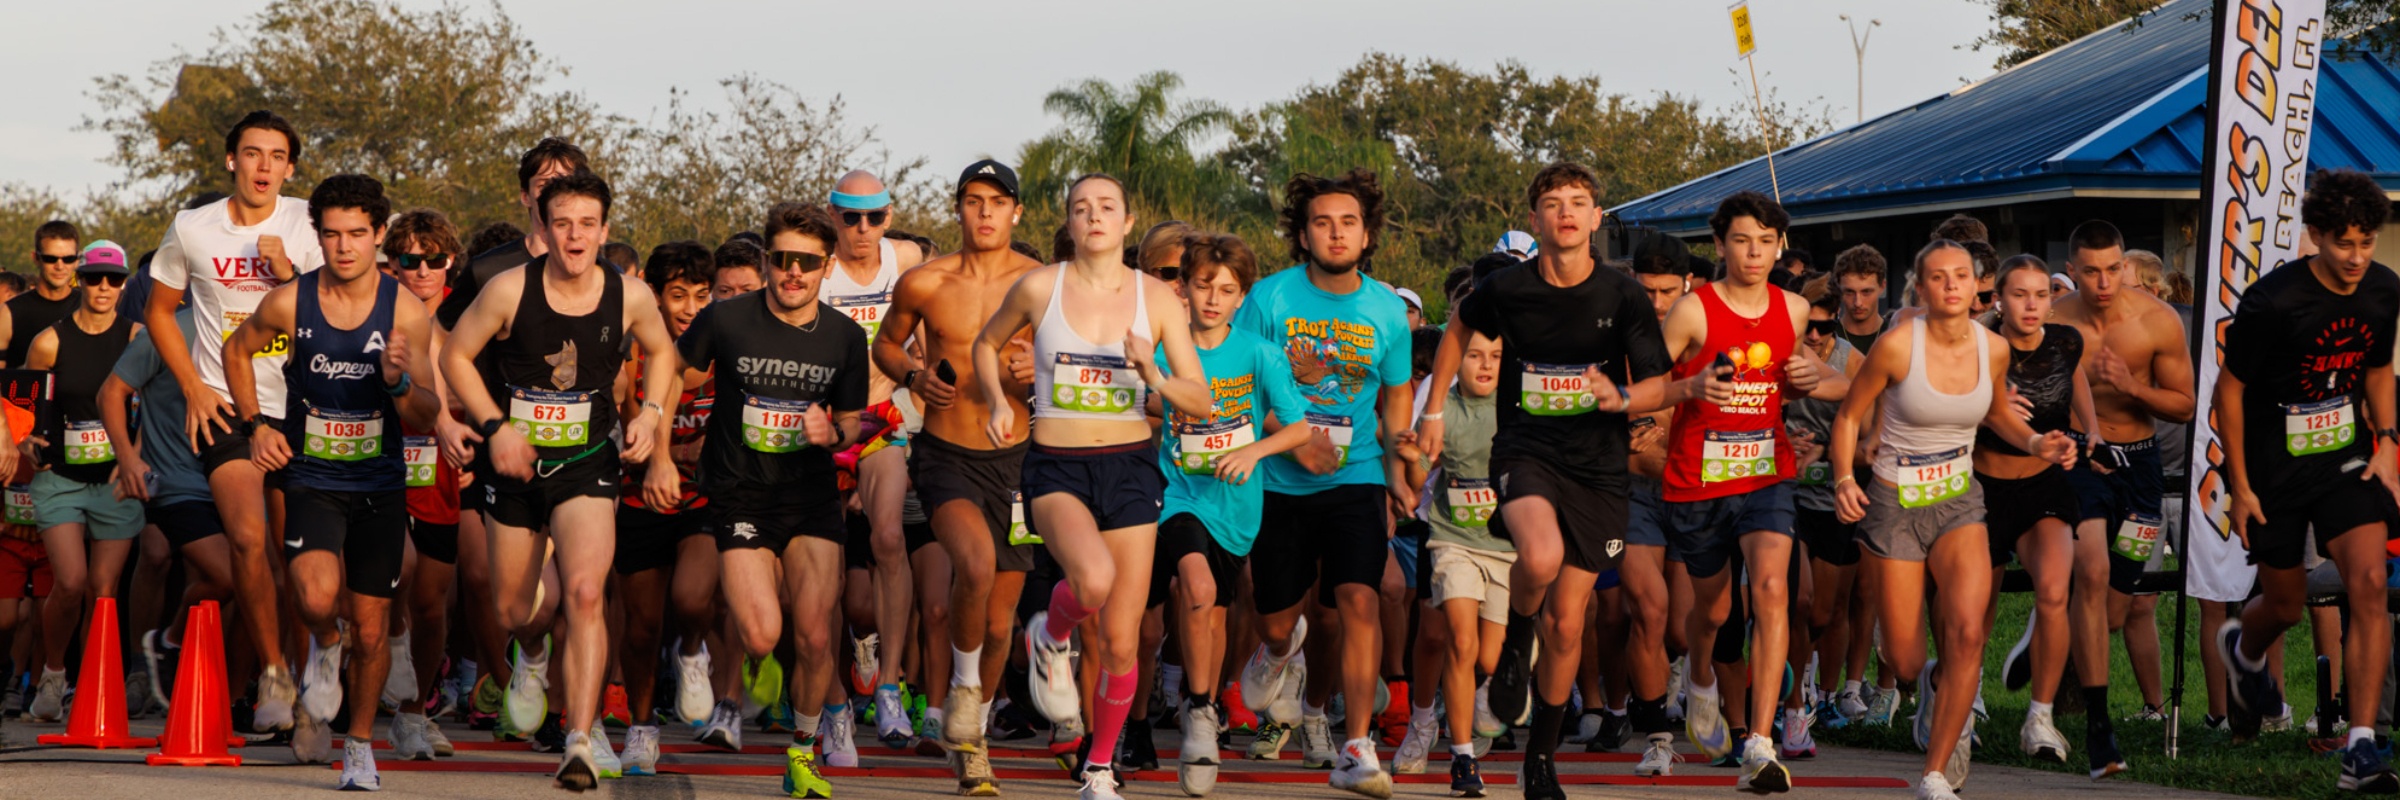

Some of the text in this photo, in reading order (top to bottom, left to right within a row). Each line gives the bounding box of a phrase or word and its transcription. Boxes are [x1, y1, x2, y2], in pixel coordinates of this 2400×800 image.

[2293, 18, 2319, 70] FL
[850, 306, 876, 321] 218
[1285, 317, 1330, 339] TROT
[1331, 317, 1375, 337] AGAINST
[1334, 330, 1375, 349] POVERTY
[310, 353, 376, 380] Ospreys
[736, 356, 837, 384] synergy
[744, 376, 826, 392] TRIATHLON
[1079, 368, 1113, 384] 873
[1210, 374, 1254, 390] AGAINST
[1541, 377, 1582, 391] 1040
[533, 405, 567, 421] 673
[762, 411, 802, 428] 1187
[2306, 411, 2340, 430] 1213
[81, 431, 106, 444] 913
[324, 421, 366, 437] 1038
[1203, 433, 1233, 450] 457
[1722, 443, 1760, 458] 1210
[1917, 463, 1952, 482] 1211
